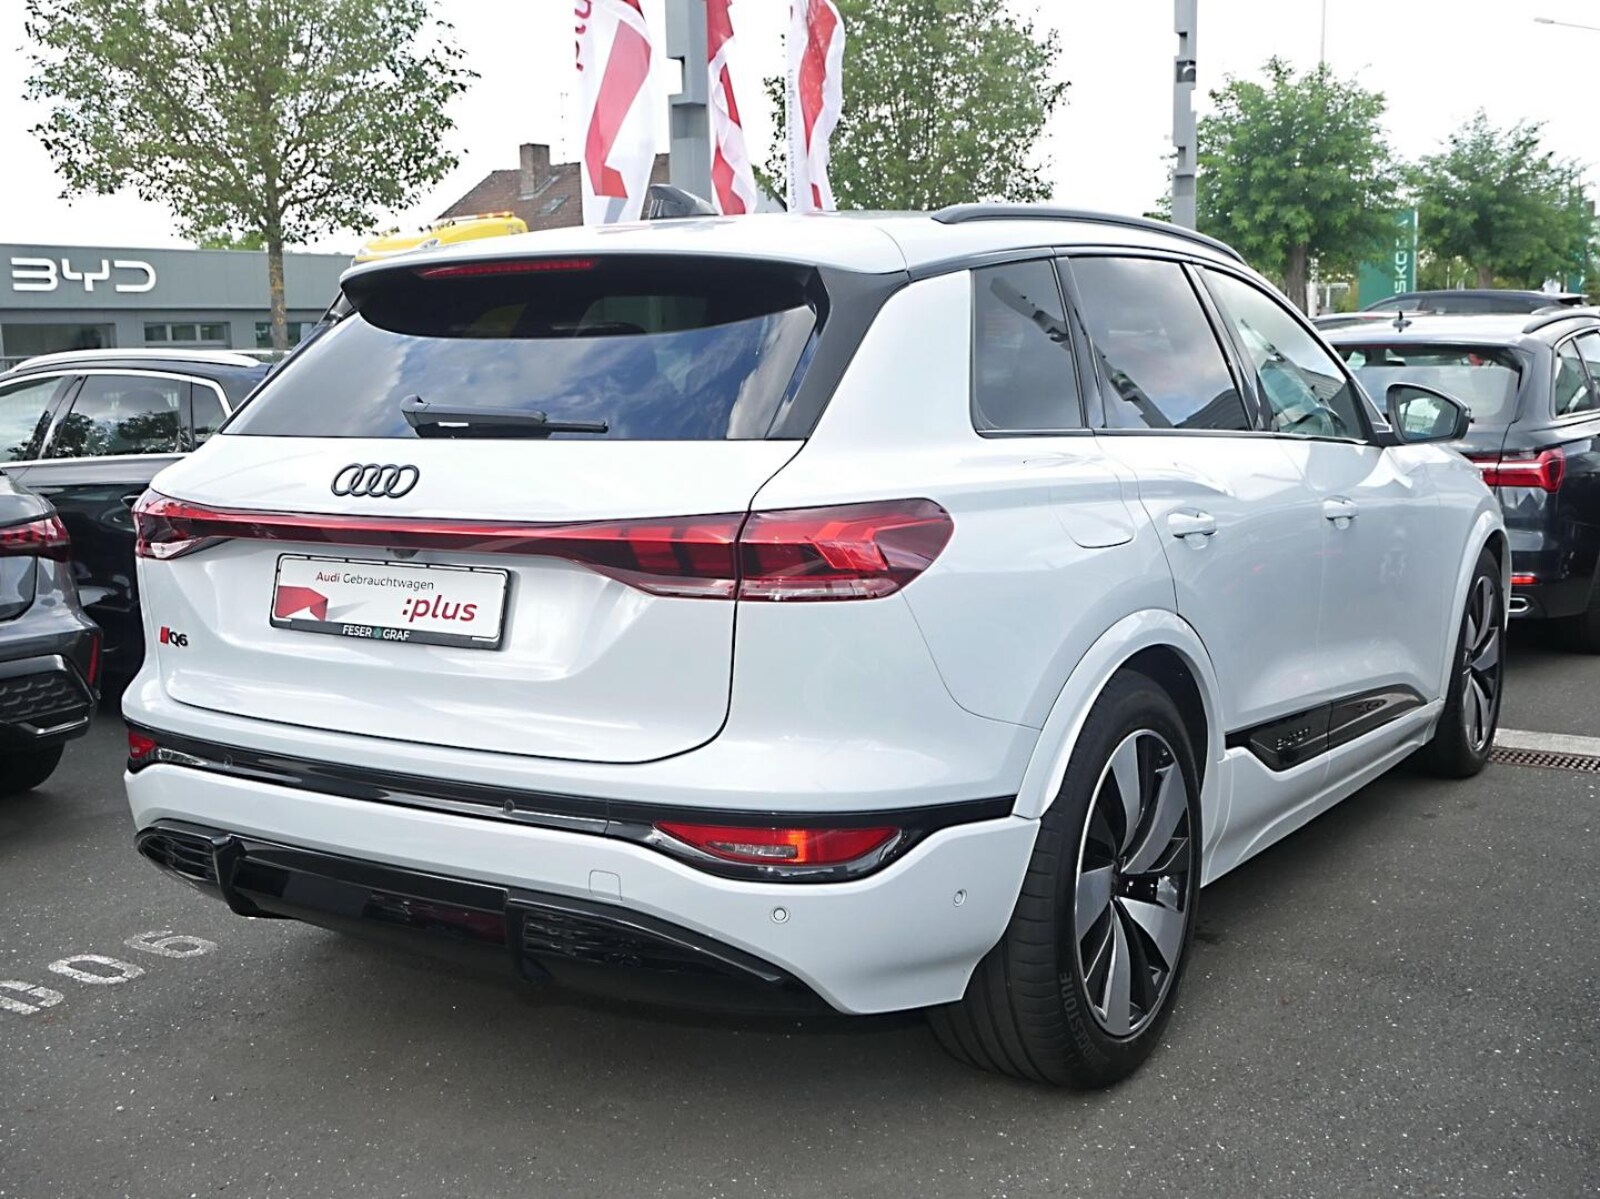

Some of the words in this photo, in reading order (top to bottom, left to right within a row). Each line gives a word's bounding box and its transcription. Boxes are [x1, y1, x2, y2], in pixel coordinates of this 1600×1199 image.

[1394, 219, 1408, 294] SKO
[11, 257, 156, 292] BYD
[315, 571, 341, 583] Audi
[343, 573, 435, 591] Gebrauchtwagen
[402, 594, 479, 623] :plus
[342, 624, 372, 638] FESER
[383, 628, 411, 642] GRAF
